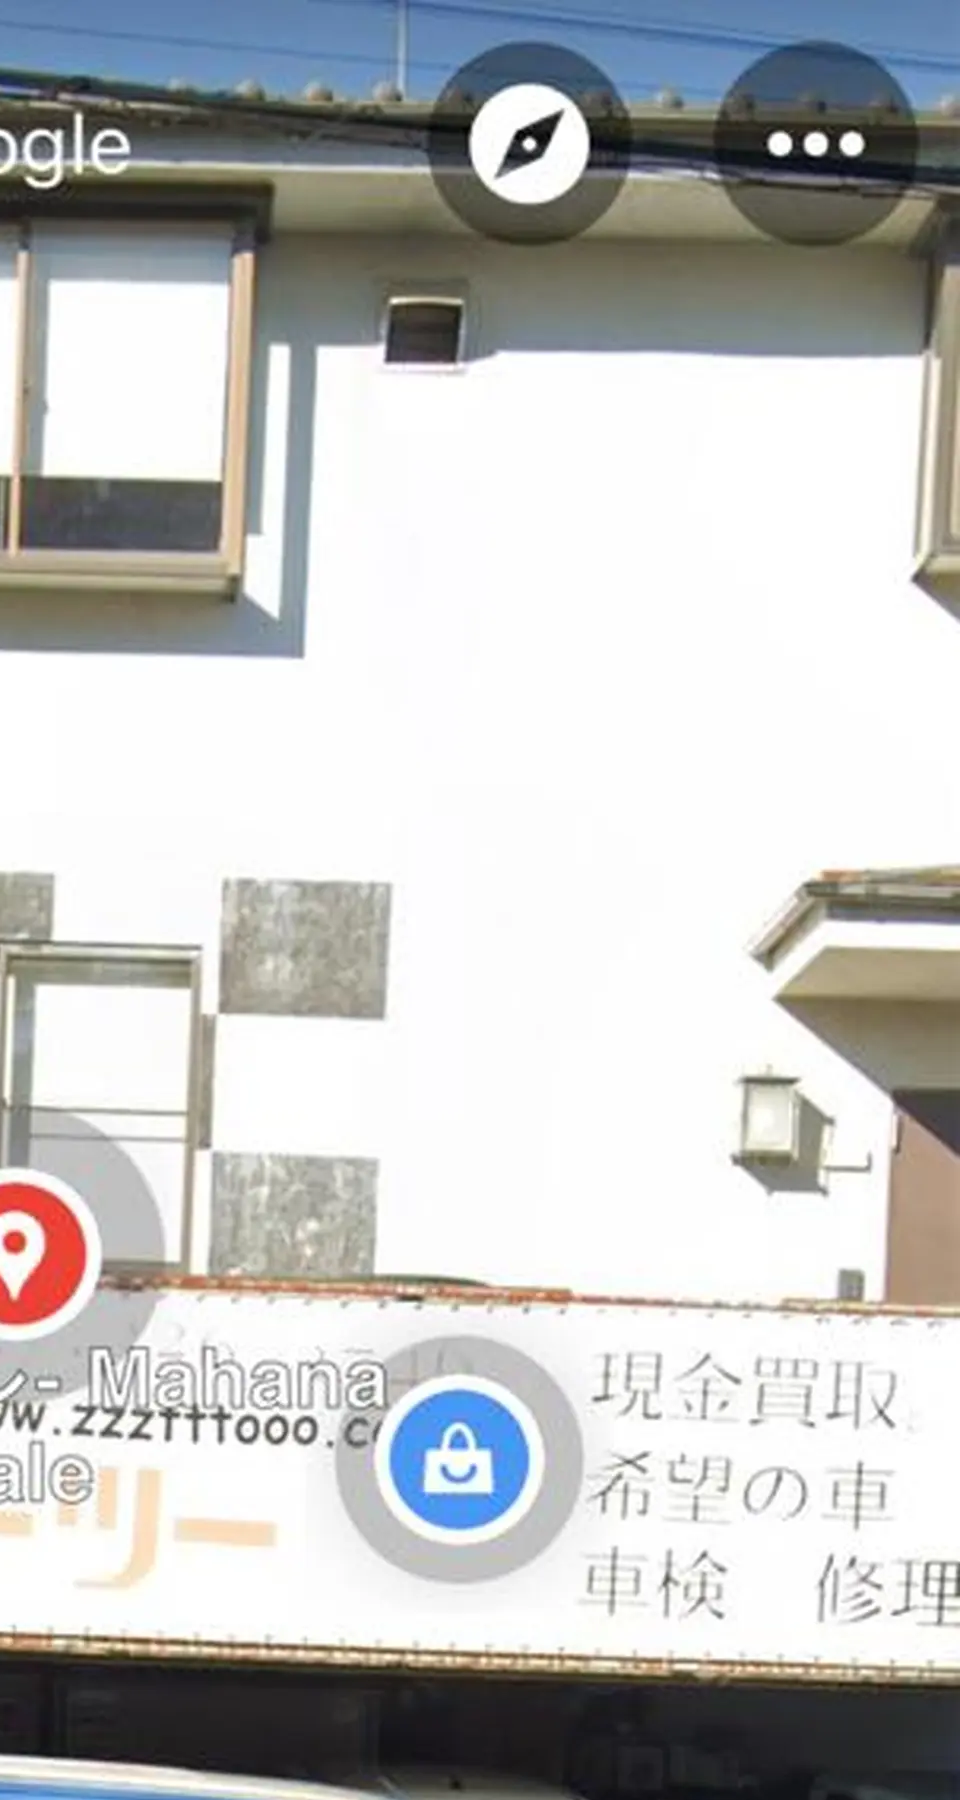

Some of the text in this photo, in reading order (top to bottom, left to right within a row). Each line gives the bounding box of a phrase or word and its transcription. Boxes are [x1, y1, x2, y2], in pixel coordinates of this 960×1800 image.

[591, 1352, 897, 1430] 現金買取
[586, 1451, 896, 1531] 希望の車
[577, 1545, 960, 1627] 車検 修理
